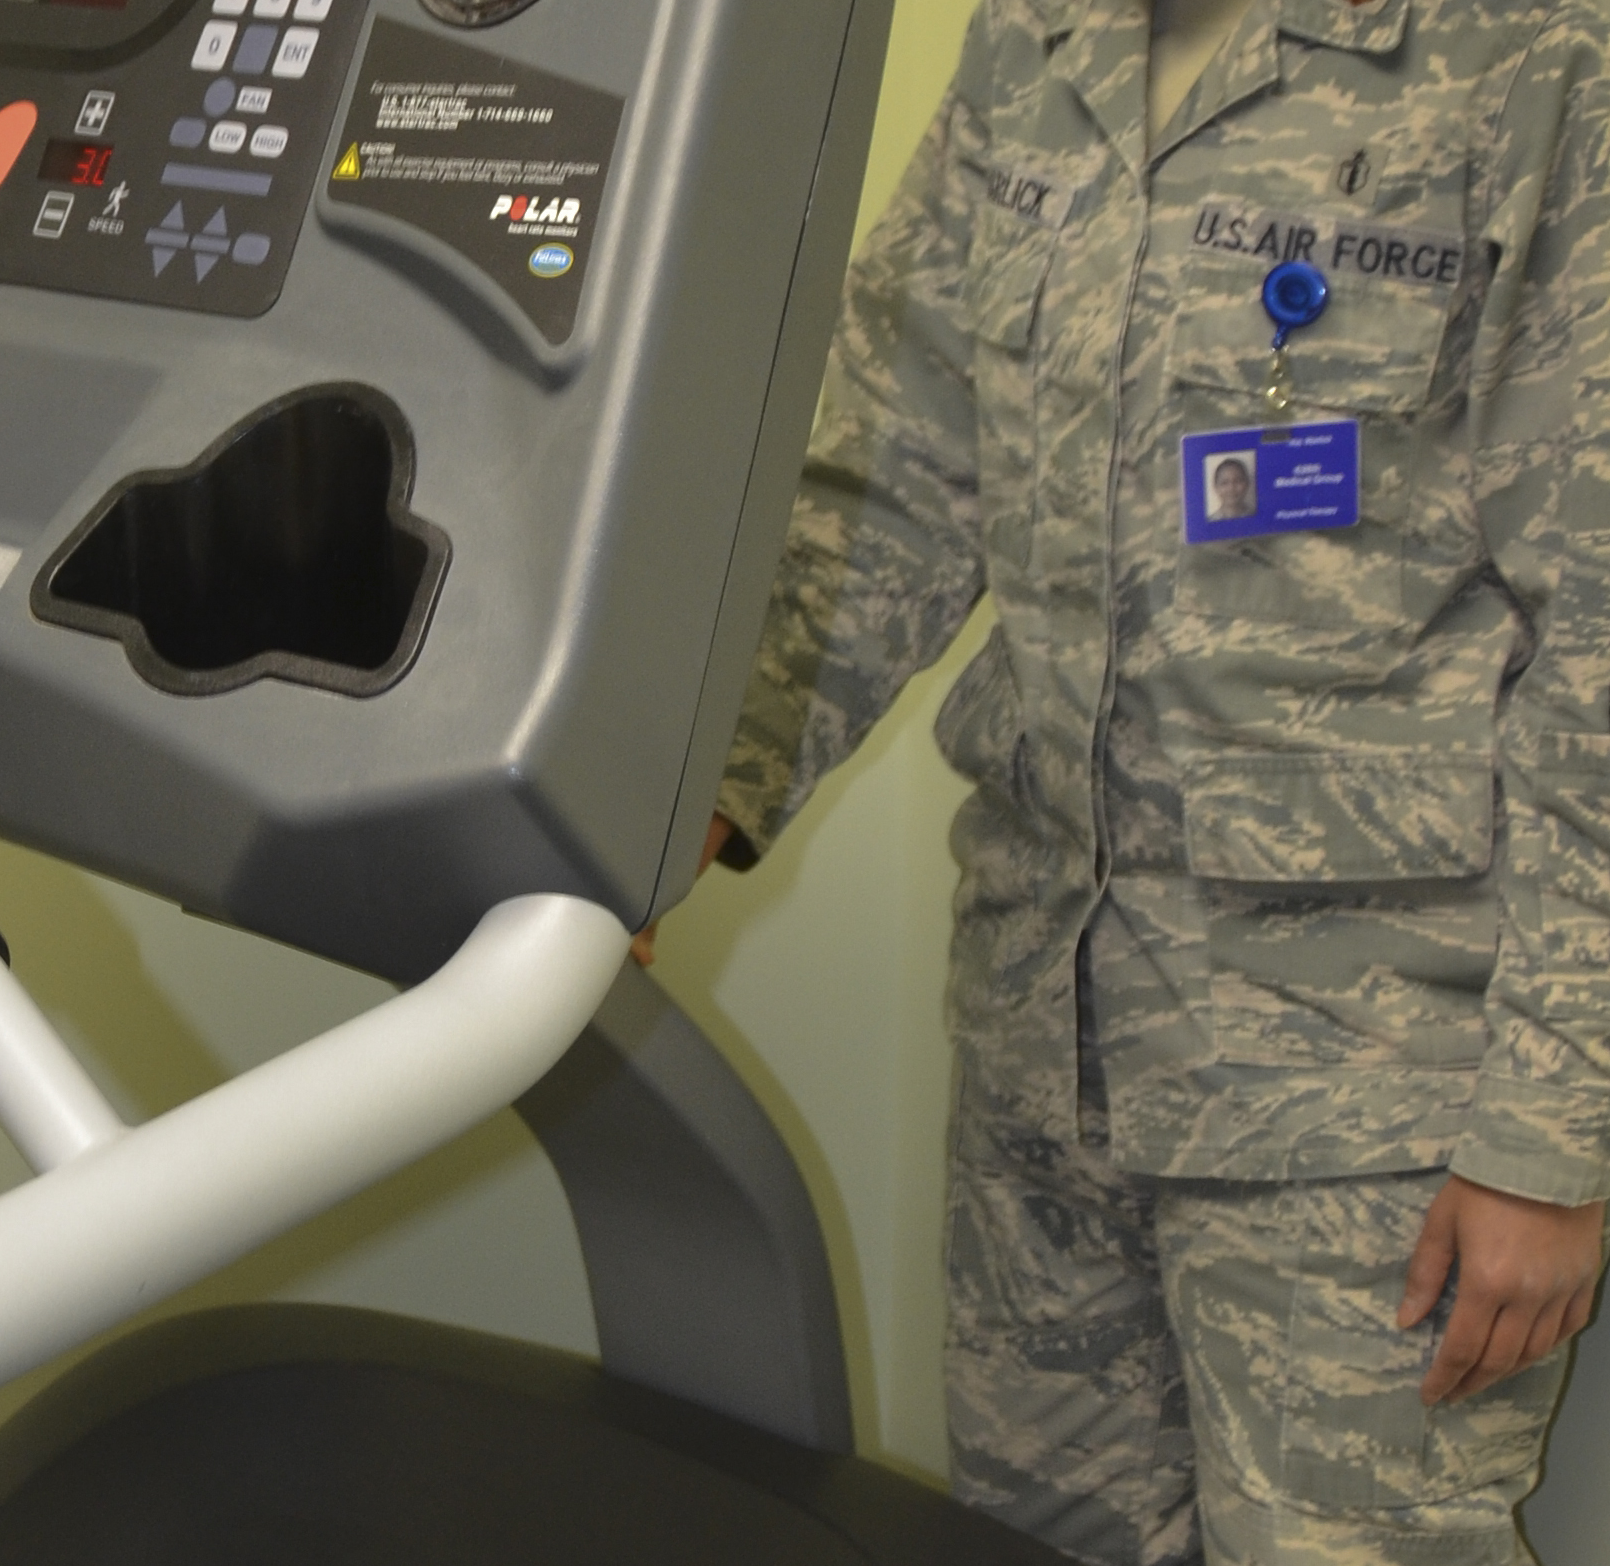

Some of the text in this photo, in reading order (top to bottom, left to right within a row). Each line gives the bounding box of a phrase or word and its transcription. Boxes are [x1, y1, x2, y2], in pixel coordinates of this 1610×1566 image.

[282, 43, 311, 64] ENT
[241, 92, 266, 108] FAN
[214, 129, 241, 145] LOW
[254, 134, 285, 150] HIGH
[490, 194, 581, 224] POLAR
[88, 216, 125, 234] SPEED
[1332, 234, 1461, 285] FORCE
